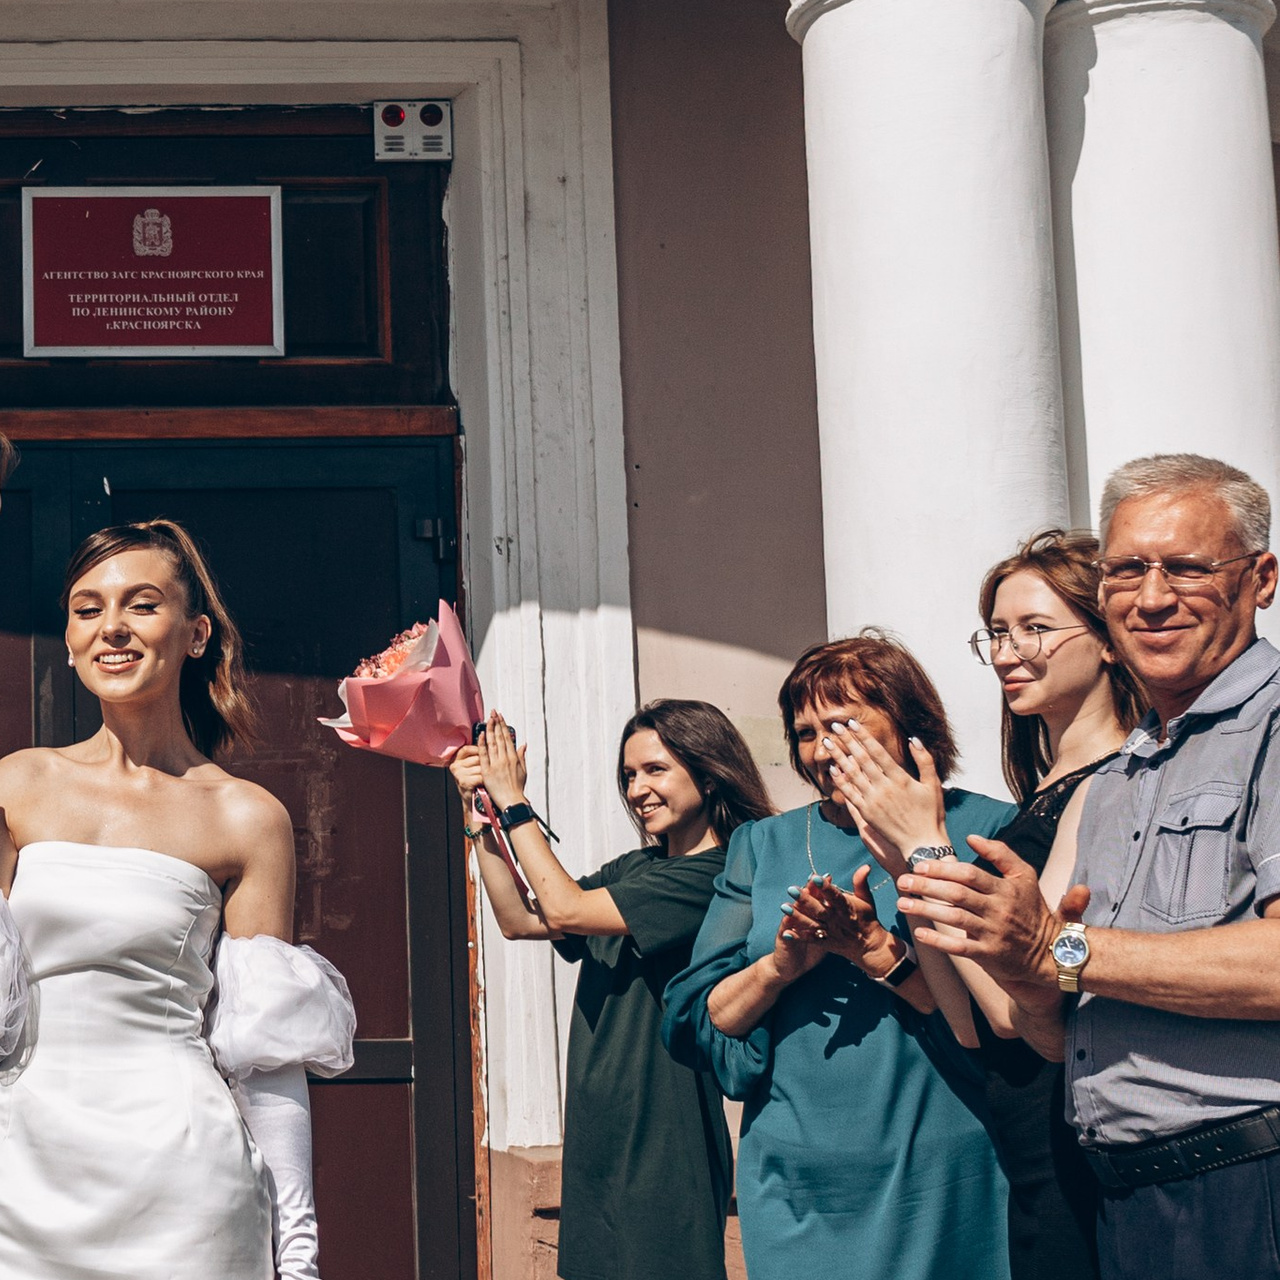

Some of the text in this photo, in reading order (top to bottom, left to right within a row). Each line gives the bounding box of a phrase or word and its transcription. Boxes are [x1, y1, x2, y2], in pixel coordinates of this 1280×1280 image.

[42, 270, 265, 280] АГЕНТСТВО ЗАГС КРАСНОЯРСКОГО КРАЯ
[68, 292, 239, 303] ТЕРРИТОРИАЛЬНЫЙ ОТДЕЛ
[72, 305, 236, 317] ПО ЛЕНИНСКОМУ РАЙОНУ
[106, 320, 202, 330] г.КРАСНОЯРСКА
